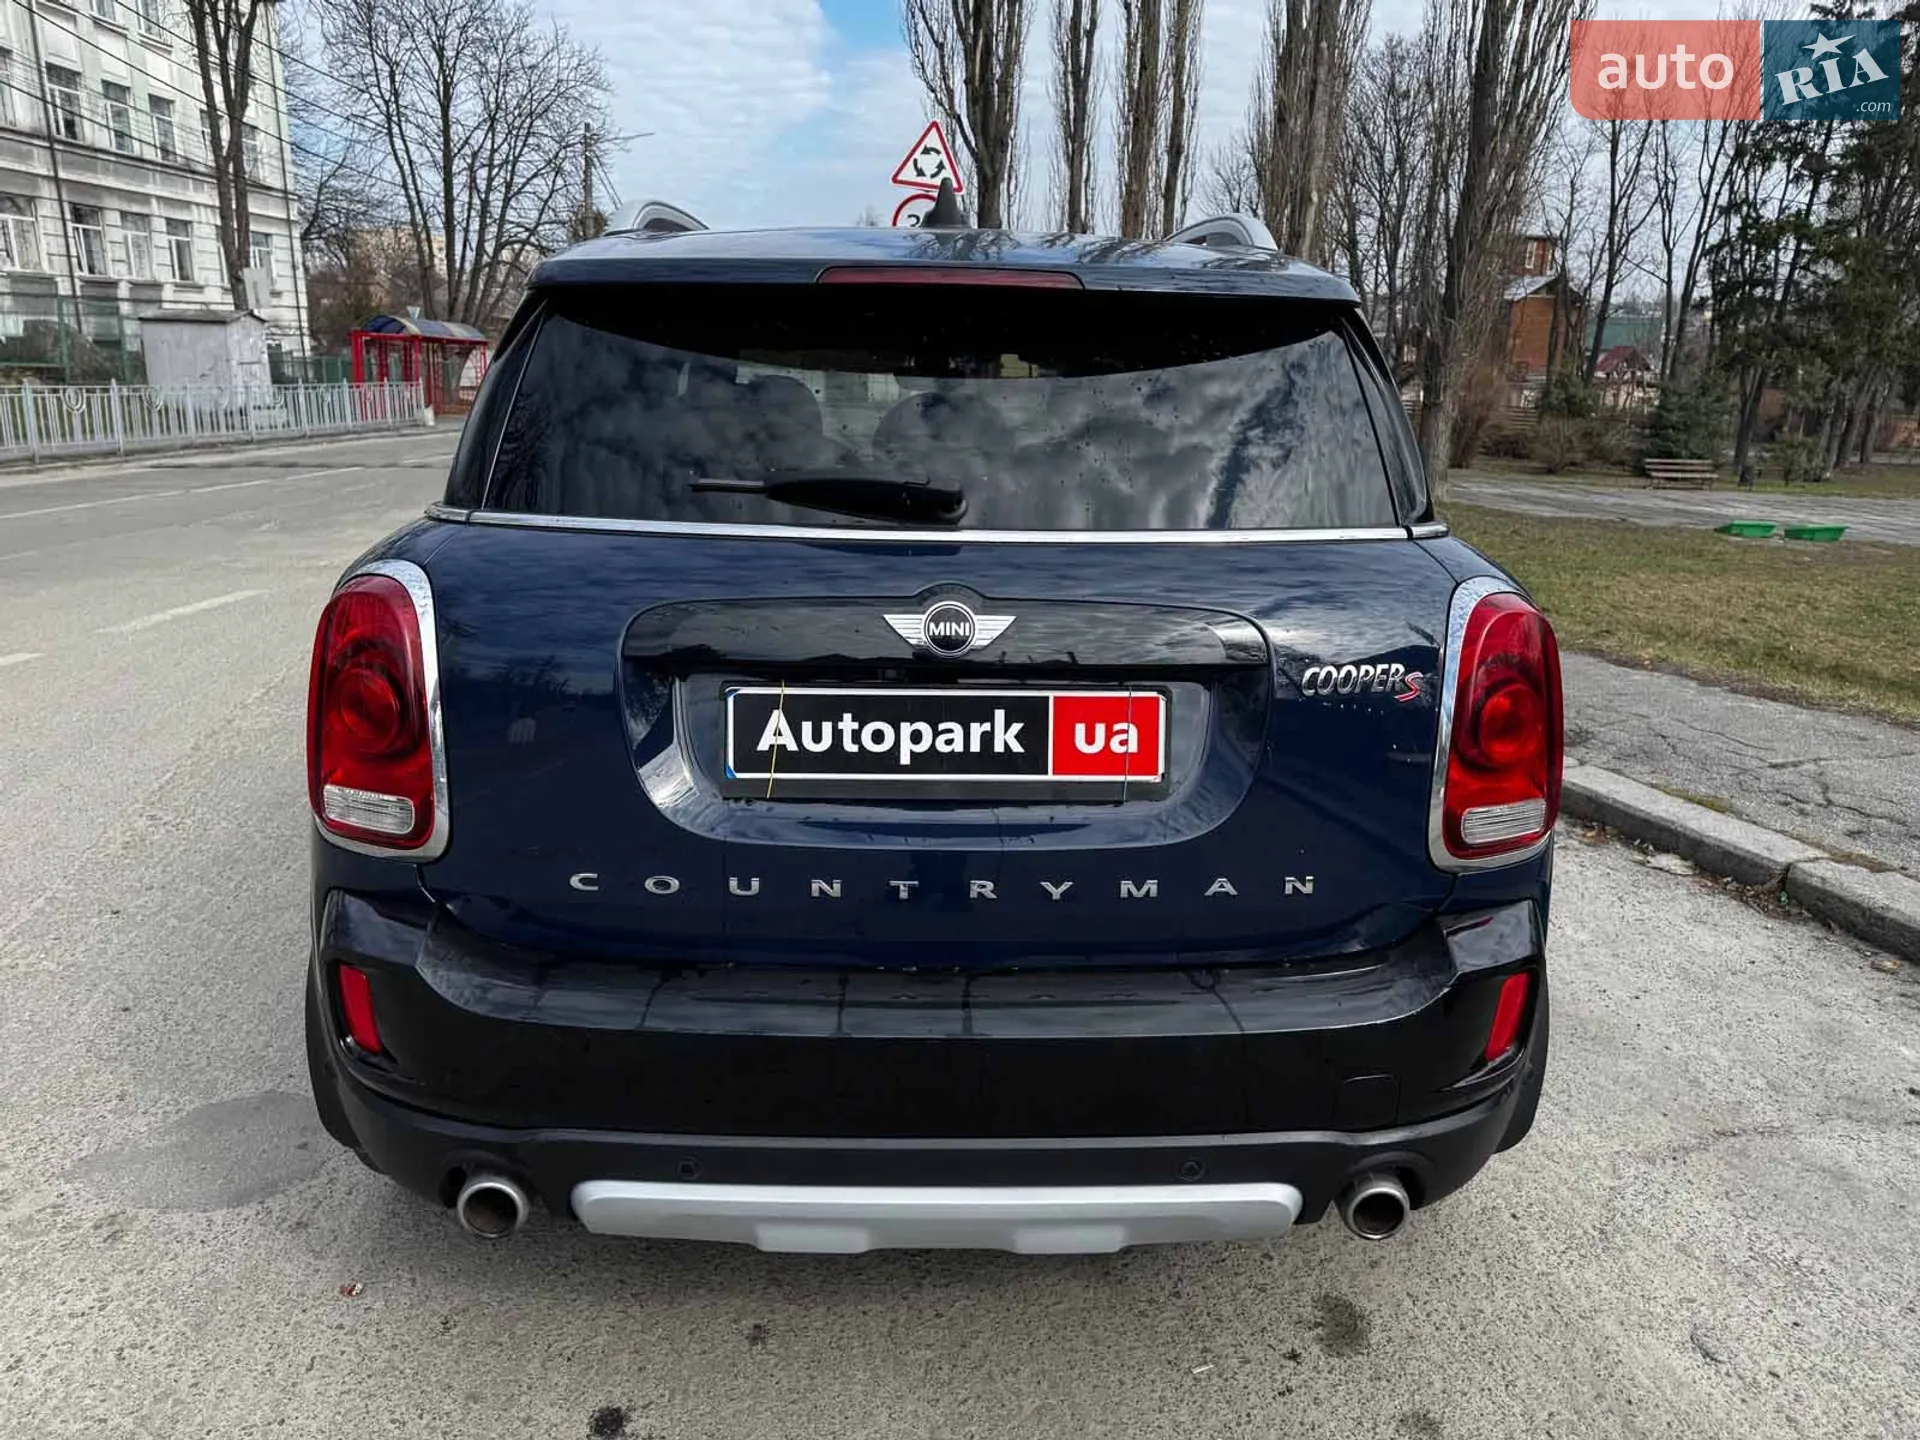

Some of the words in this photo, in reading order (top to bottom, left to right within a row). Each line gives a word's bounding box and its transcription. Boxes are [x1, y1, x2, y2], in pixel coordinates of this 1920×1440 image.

[928, 620, 970, 638] MINI
[756, 709, 1025, 765] Autopark
[1074, 720, 1138, 754] ua
[569, 873, 1314, 901] COUNTRYMAN
